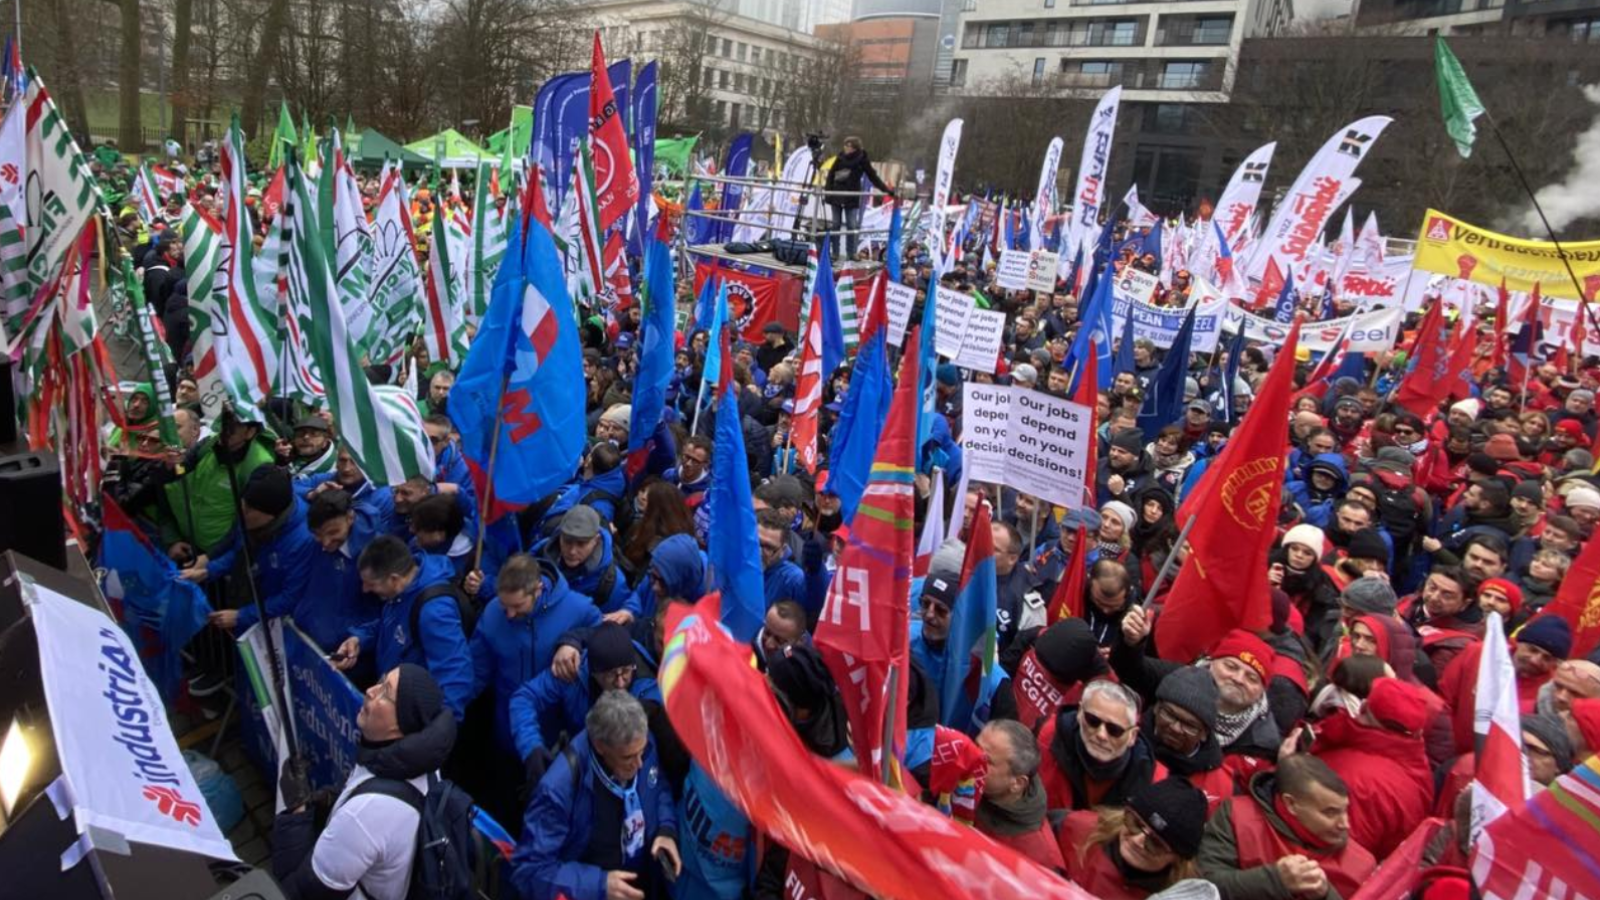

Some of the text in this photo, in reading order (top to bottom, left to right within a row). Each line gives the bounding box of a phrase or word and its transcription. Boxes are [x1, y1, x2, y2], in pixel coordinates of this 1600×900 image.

[1126, 270, 1153, 287] Save
[1321, 326, 1390, 343] Seel
[971, 390, 993, 402] Our
[1019, 395, 1079, 423] Our jobs
[974, 426, 990, 434] on
[1020, 415, 1076, 440] depend
[1019, 433, 1075, 458] on your
[1007, 447, 1082, 480] decisions!
[1021, 678, 1048, 716] CGIL
